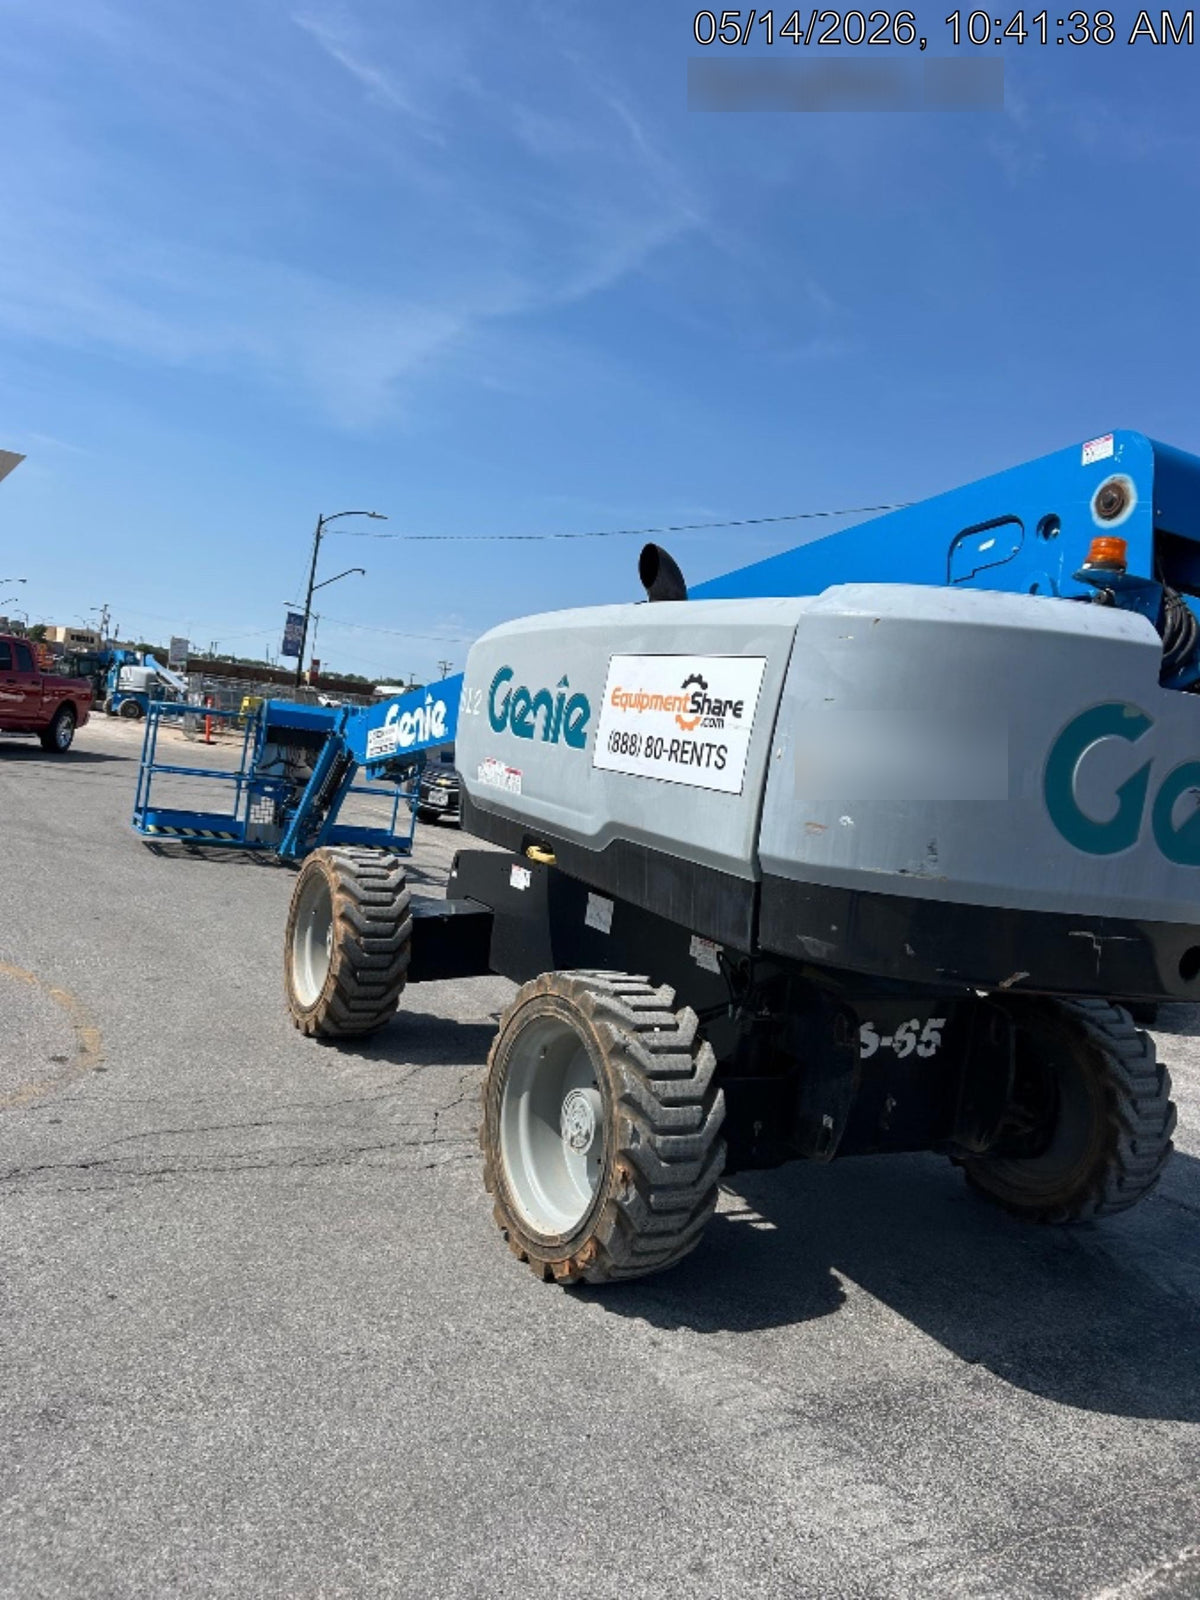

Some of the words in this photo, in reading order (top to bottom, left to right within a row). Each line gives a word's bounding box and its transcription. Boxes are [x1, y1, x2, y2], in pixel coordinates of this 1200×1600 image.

[489, 665, 590, 749] Genie
[608, 730, 642, 757] (888)
[644, 735, 728, 770] 80-RENTS
[859, 1018, 947, 1059] S-65
